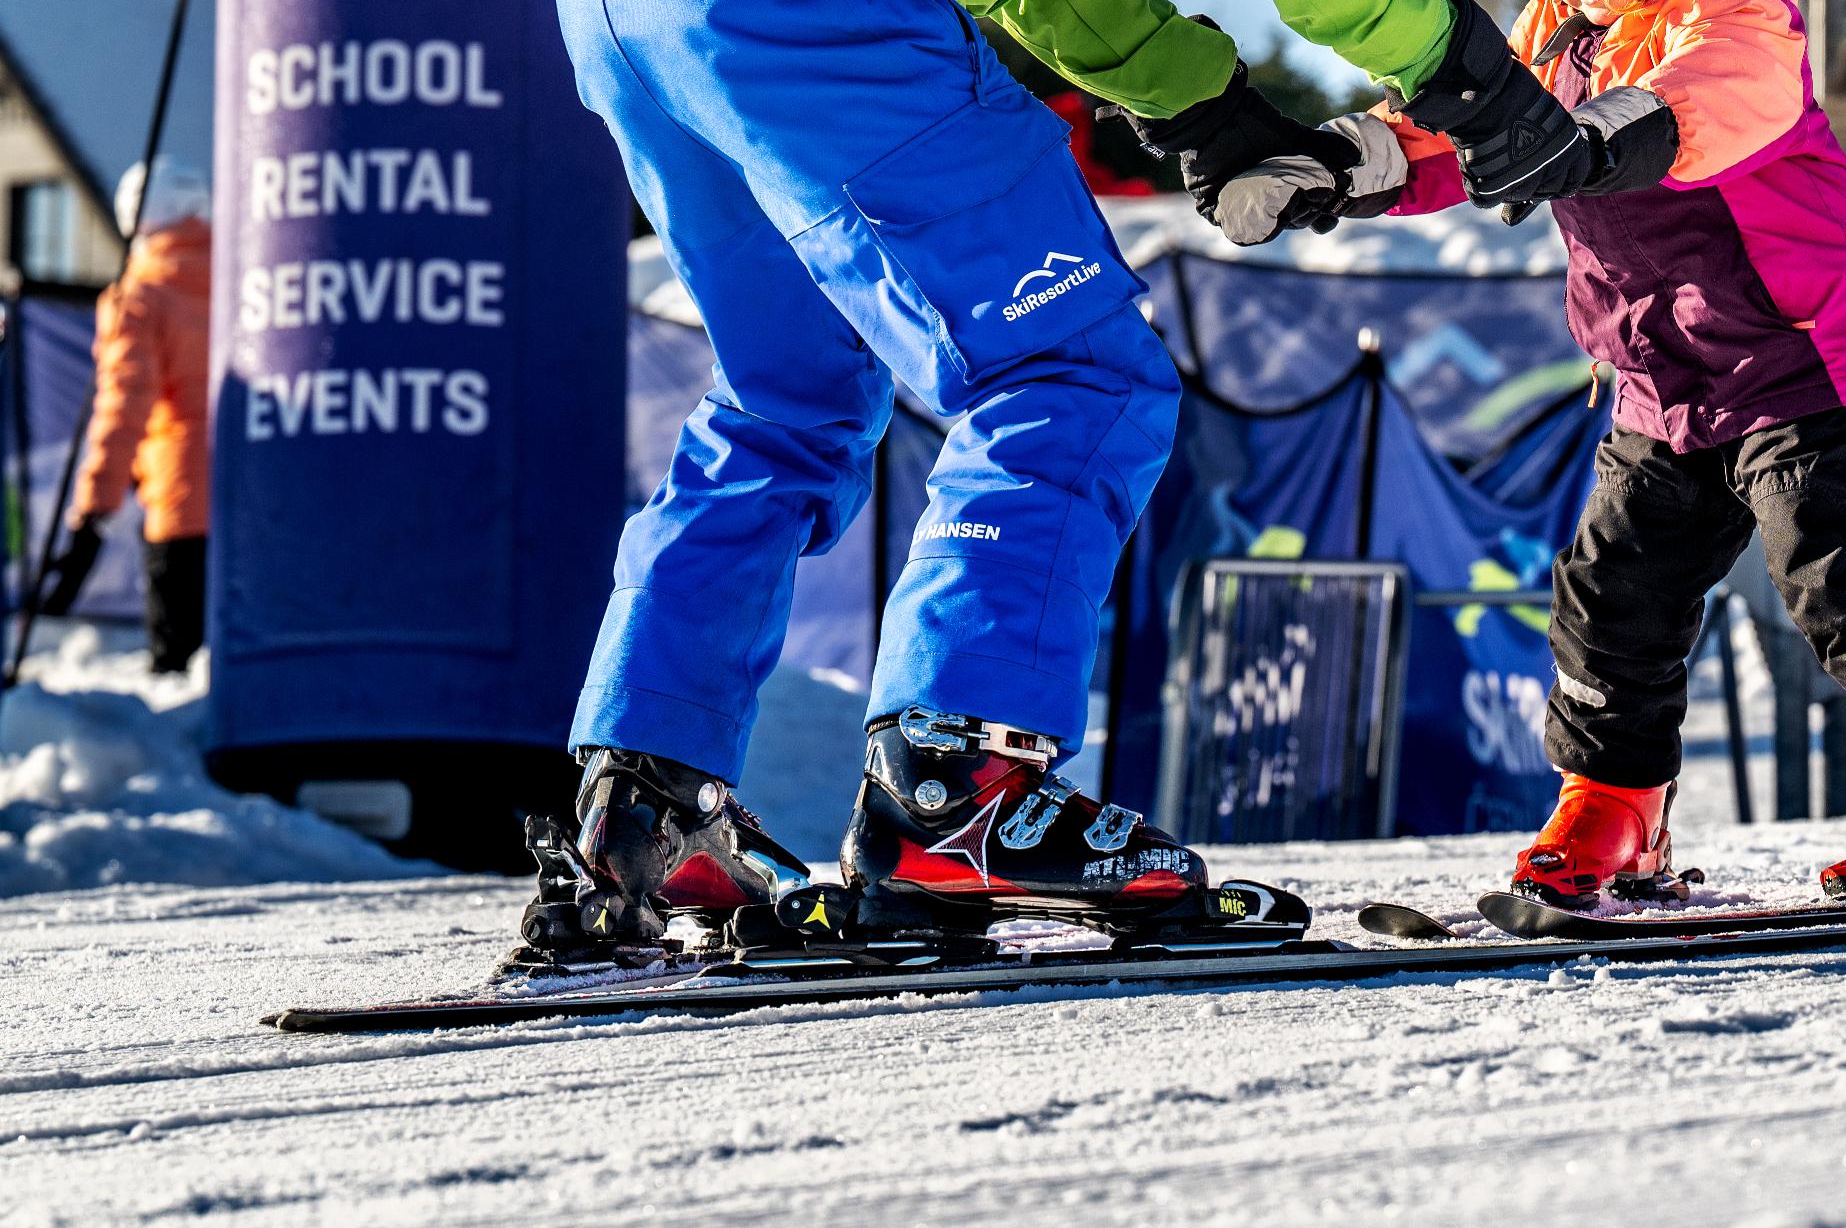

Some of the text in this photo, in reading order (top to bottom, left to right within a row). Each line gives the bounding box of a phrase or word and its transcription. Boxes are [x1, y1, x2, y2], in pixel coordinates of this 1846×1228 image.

[247, 39, 503, 115] SCHOOL
[251, 149, 491, 222] RENTAL
[240, 258, 504, 332] SERVICE
[1003, 261, 1101, 322] SkiResortLive
[245, 369, 489, 441] EVENTS
[925, 521, 1001, 541] HANSEN
